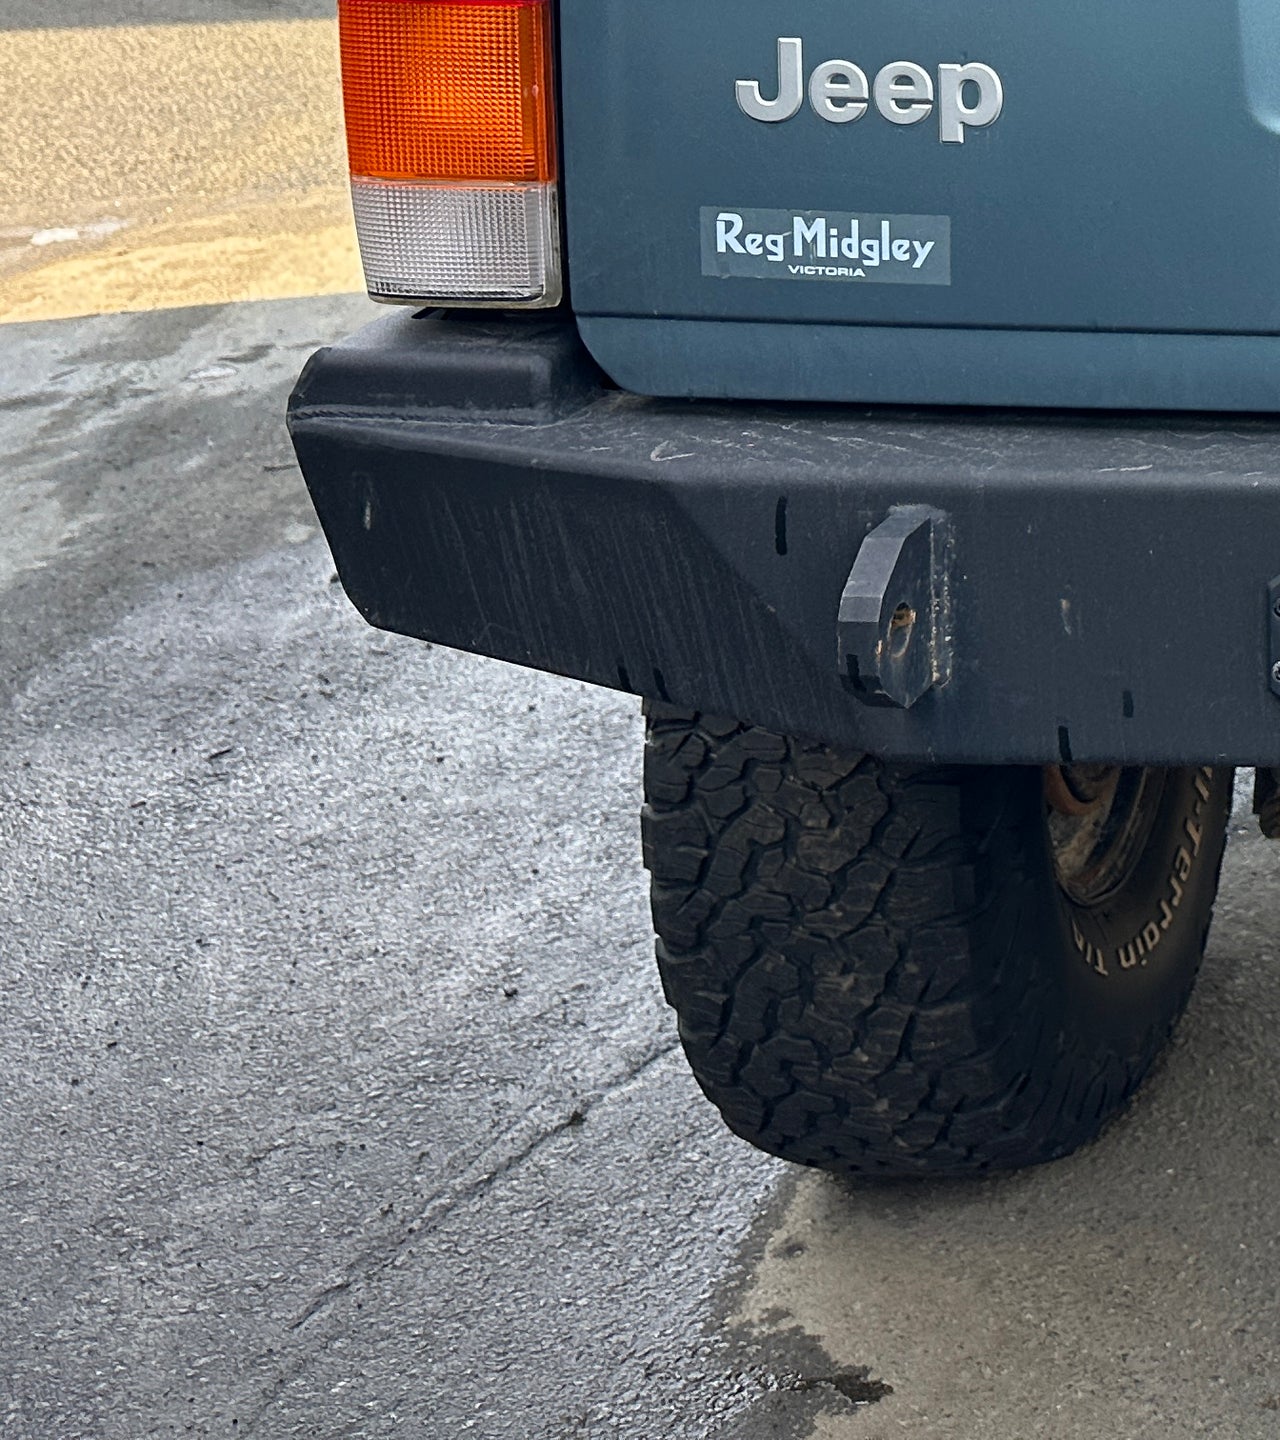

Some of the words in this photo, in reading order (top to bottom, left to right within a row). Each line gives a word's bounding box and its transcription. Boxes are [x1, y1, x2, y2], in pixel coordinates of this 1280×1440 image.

[735, 37, 1004, 144] Jeep
[715, 212, 790, 262] Reg
[792, 216, 936, 269] Midgley
[787, 264, 867, 278] VICTORIA
